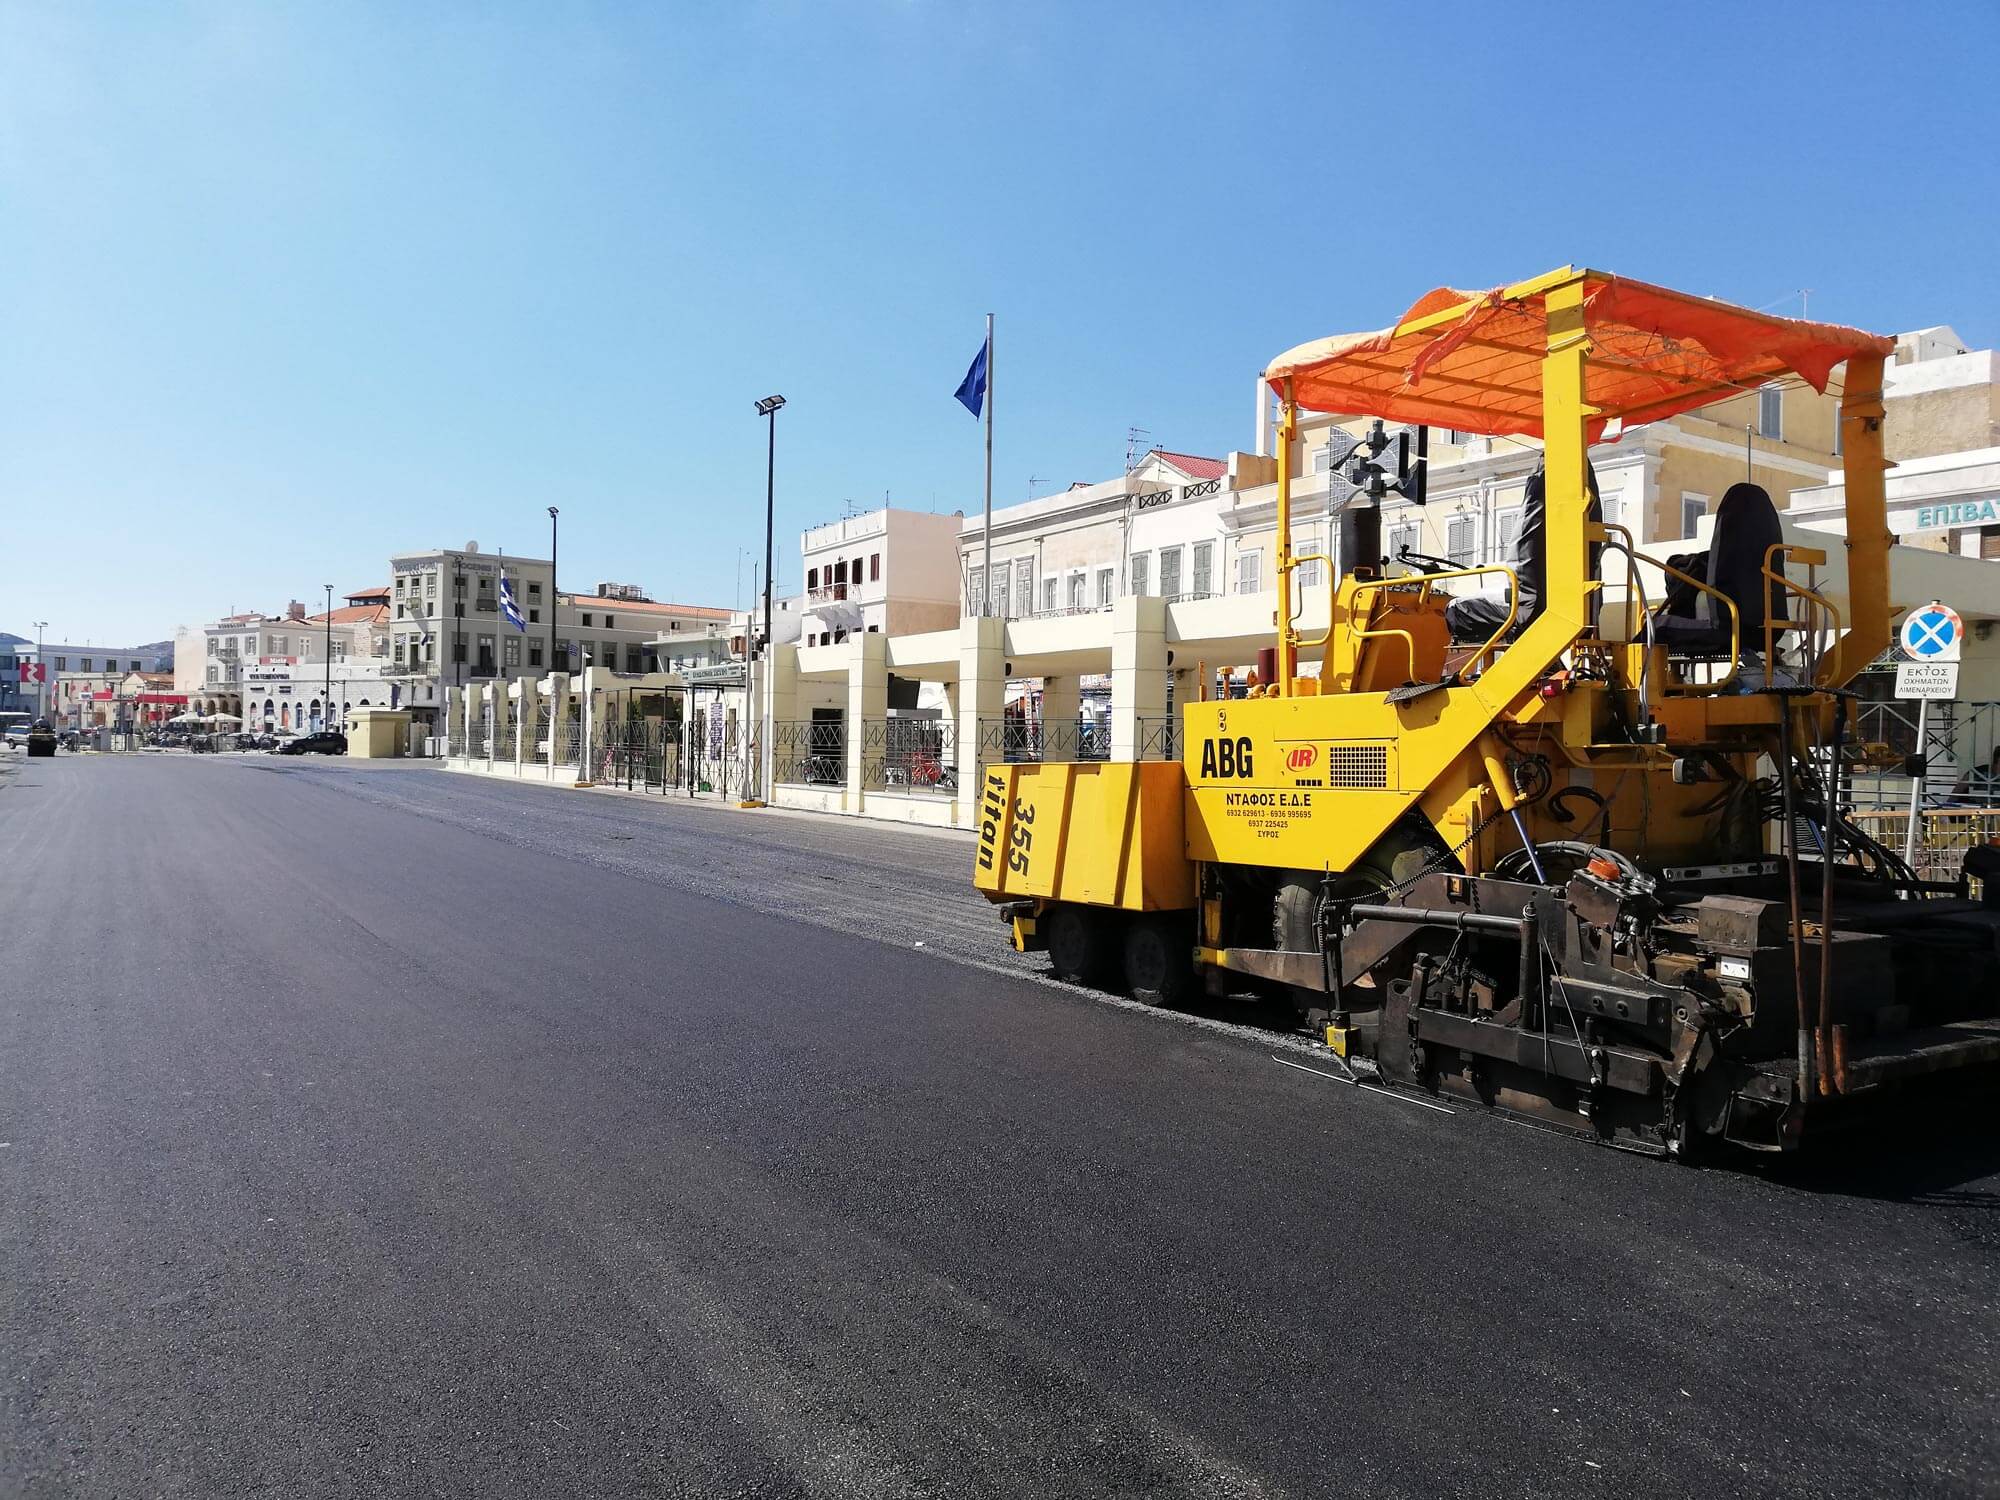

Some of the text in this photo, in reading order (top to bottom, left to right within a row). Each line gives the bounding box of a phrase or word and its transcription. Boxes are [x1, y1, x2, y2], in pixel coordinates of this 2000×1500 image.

[1907, 668, 1949, 676] ΕΚΤΟΣ
[1898, 686, 1953, 694] ΛΙΜΕΝΑΡΧΕΙΟΥ
[1201, 737, 1253, 778] ABG
[1291, 749, 1313, 768] IR
[1226, 793, 1311, 807] ΝΤΑΦΟΣ Ε.Δ.Ε
[1226, 809, 1241, 817] 6932
[1270, 810, 1286, 818] 6936
[1248, 819, 1263, 828] 6937
[1008, 798, 1035, 877] 355
[1257, 830, 1279, 838] ΣΥΡΟΣ
